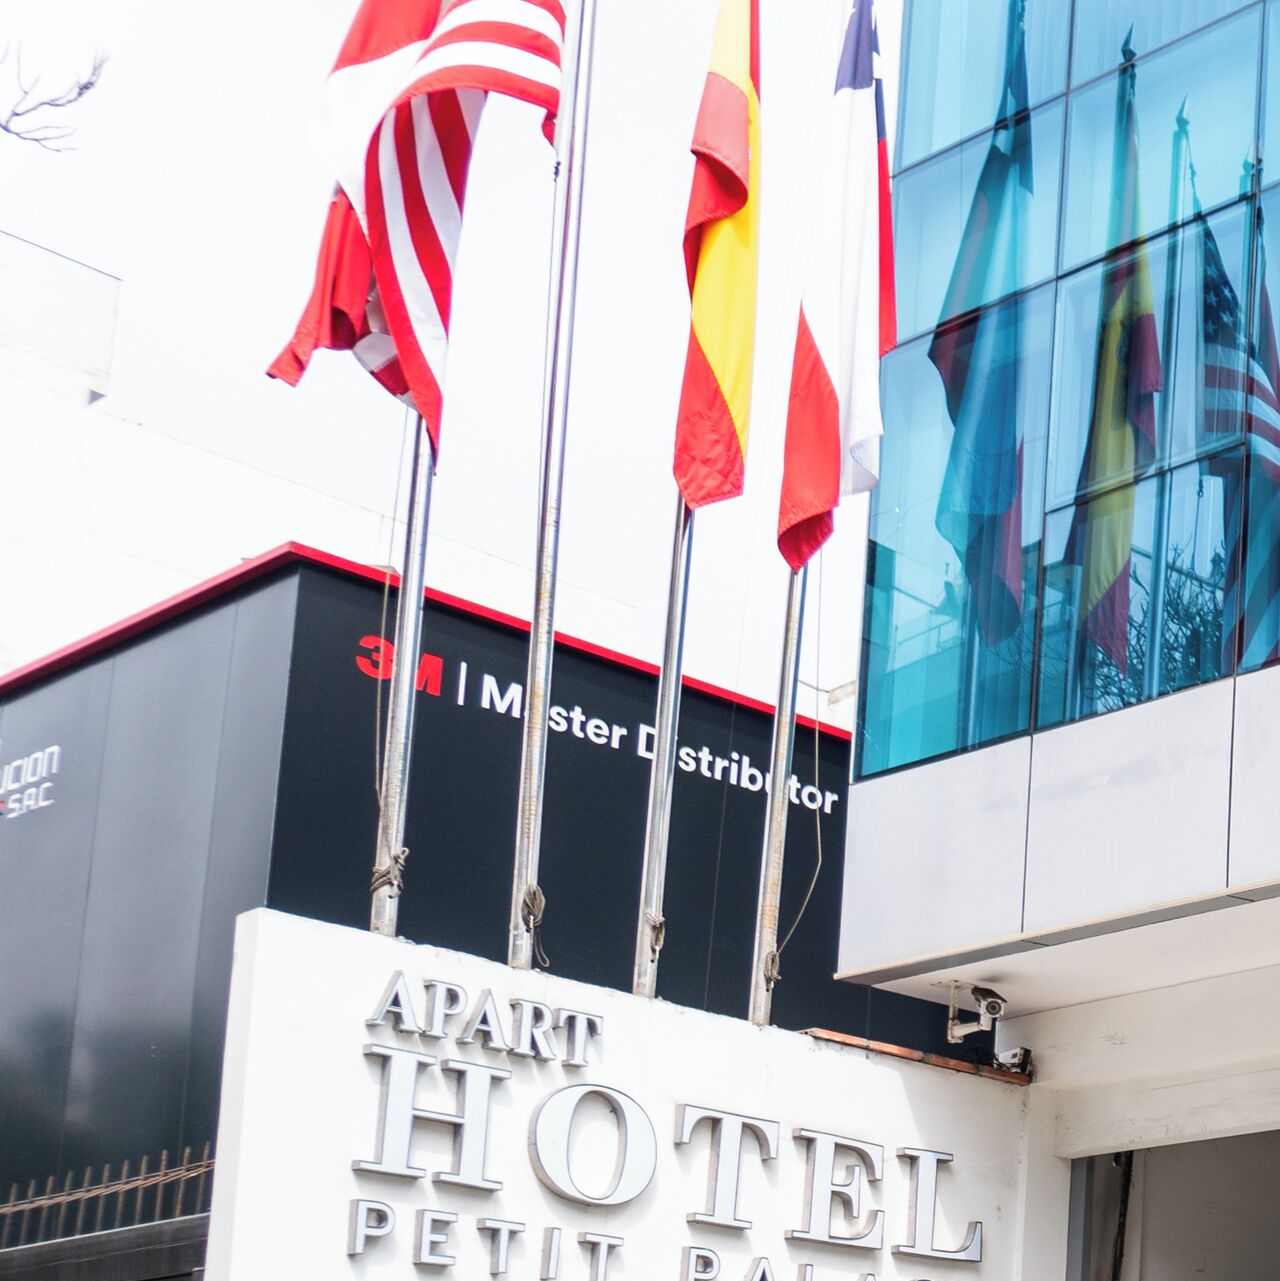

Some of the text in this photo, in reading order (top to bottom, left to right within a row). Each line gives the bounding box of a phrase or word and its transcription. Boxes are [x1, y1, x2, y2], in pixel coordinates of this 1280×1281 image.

[480, 673, 628, 750] Mster
[637, 723, 839, 814] Dstribtor
[365, 970, 603, 1068] APART
[351, 1043, 983, 1263] HOTEL
